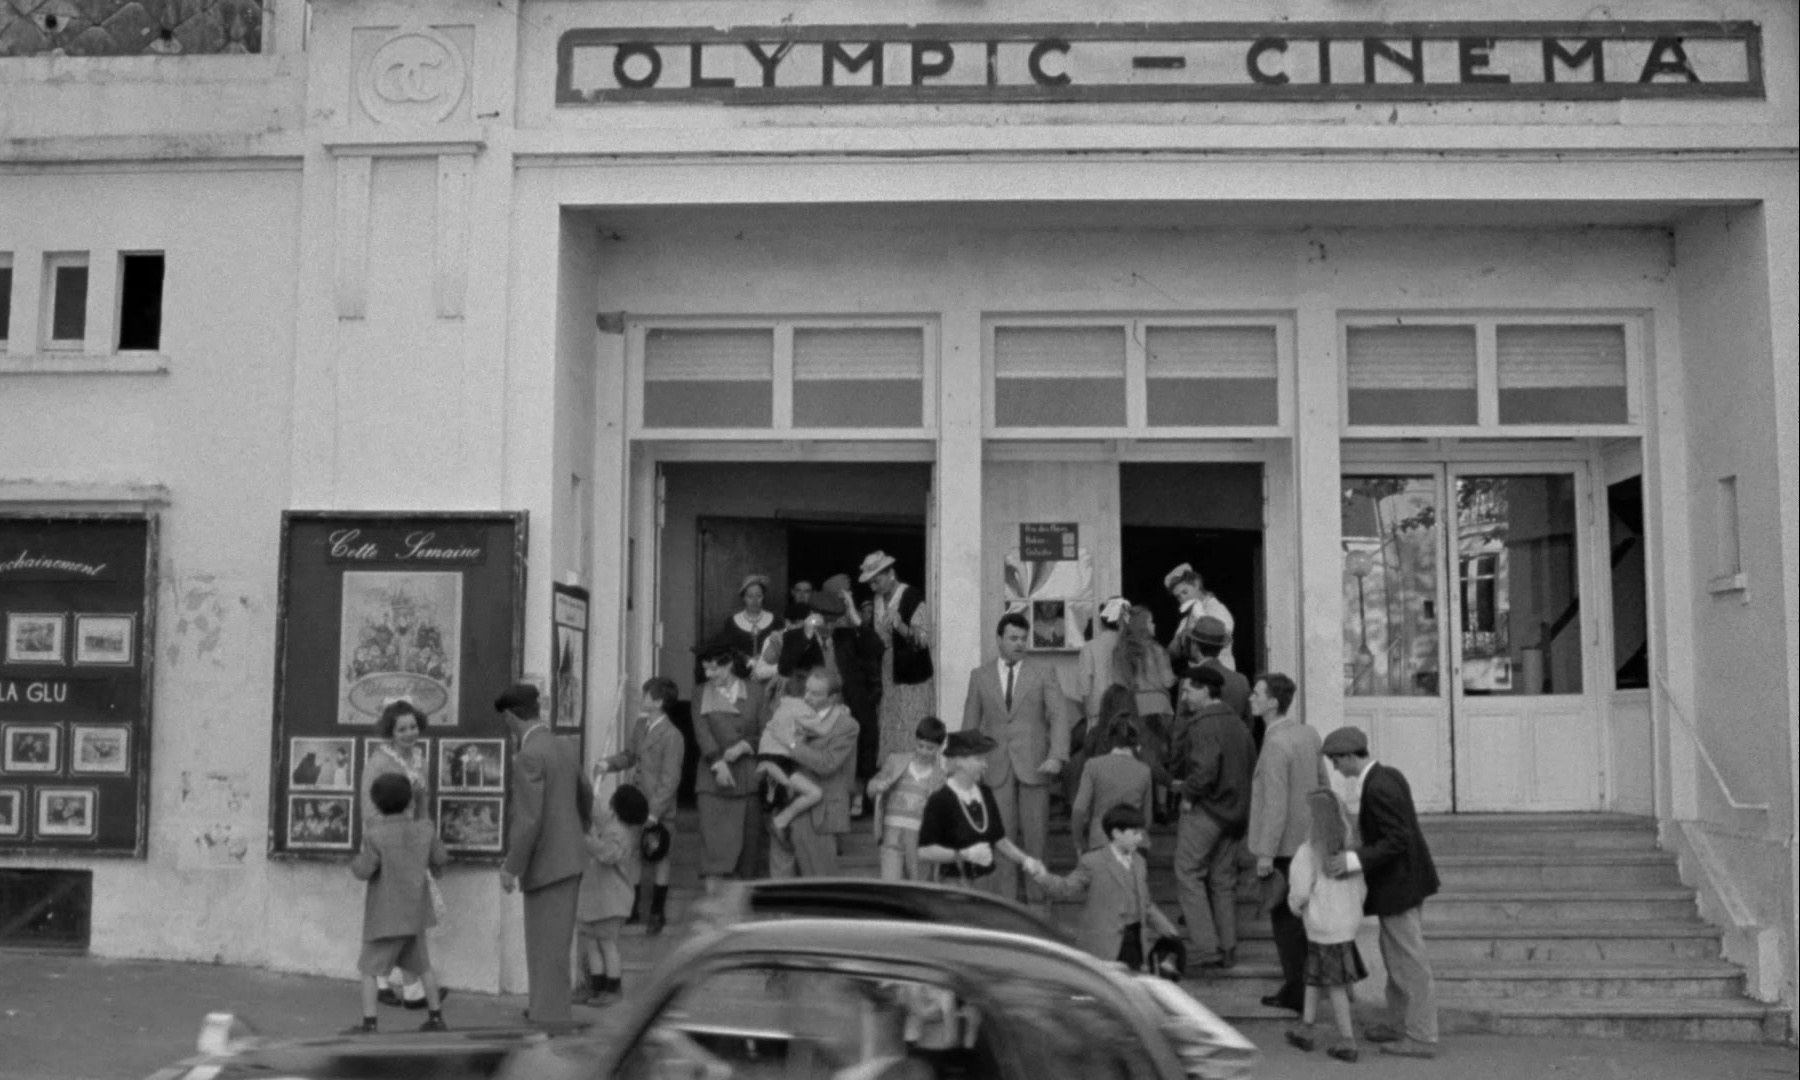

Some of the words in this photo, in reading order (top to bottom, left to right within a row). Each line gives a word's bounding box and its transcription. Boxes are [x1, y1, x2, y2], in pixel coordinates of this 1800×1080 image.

[613, 41, 1072, 88] OLYMPIC
[1245, 37, 1701, 85] CINEMA
[328, 528, 379, 559] Cette
[395, 530, 482, 559] Semaine
[26, 682, 67, 702] GLU
